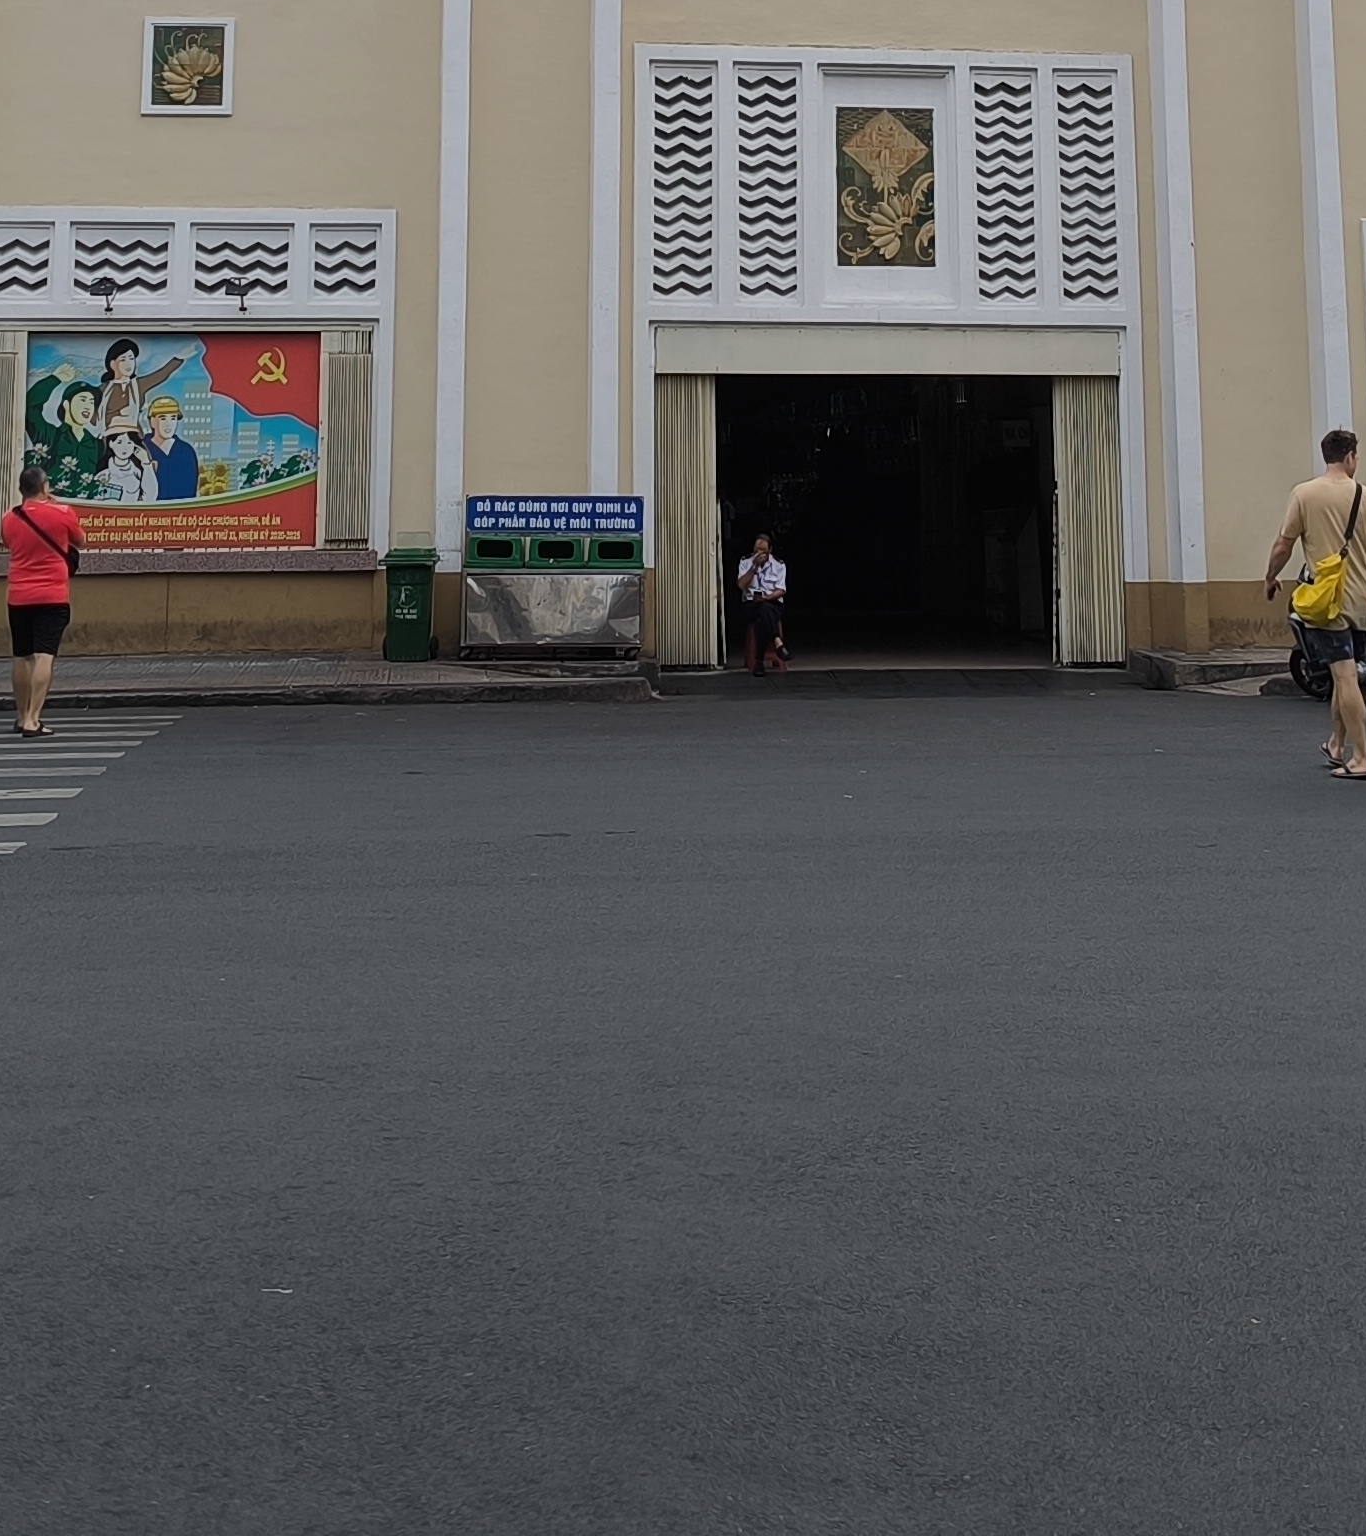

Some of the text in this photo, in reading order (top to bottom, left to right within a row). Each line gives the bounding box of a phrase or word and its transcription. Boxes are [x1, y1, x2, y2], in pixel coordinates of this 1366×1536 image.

[494, 499, 516, 513] RÁC
[572, 502, 593, 514] QUY
[624, 500, 637, 514] LÀ
[569, 516, 591, 529] MÔI
